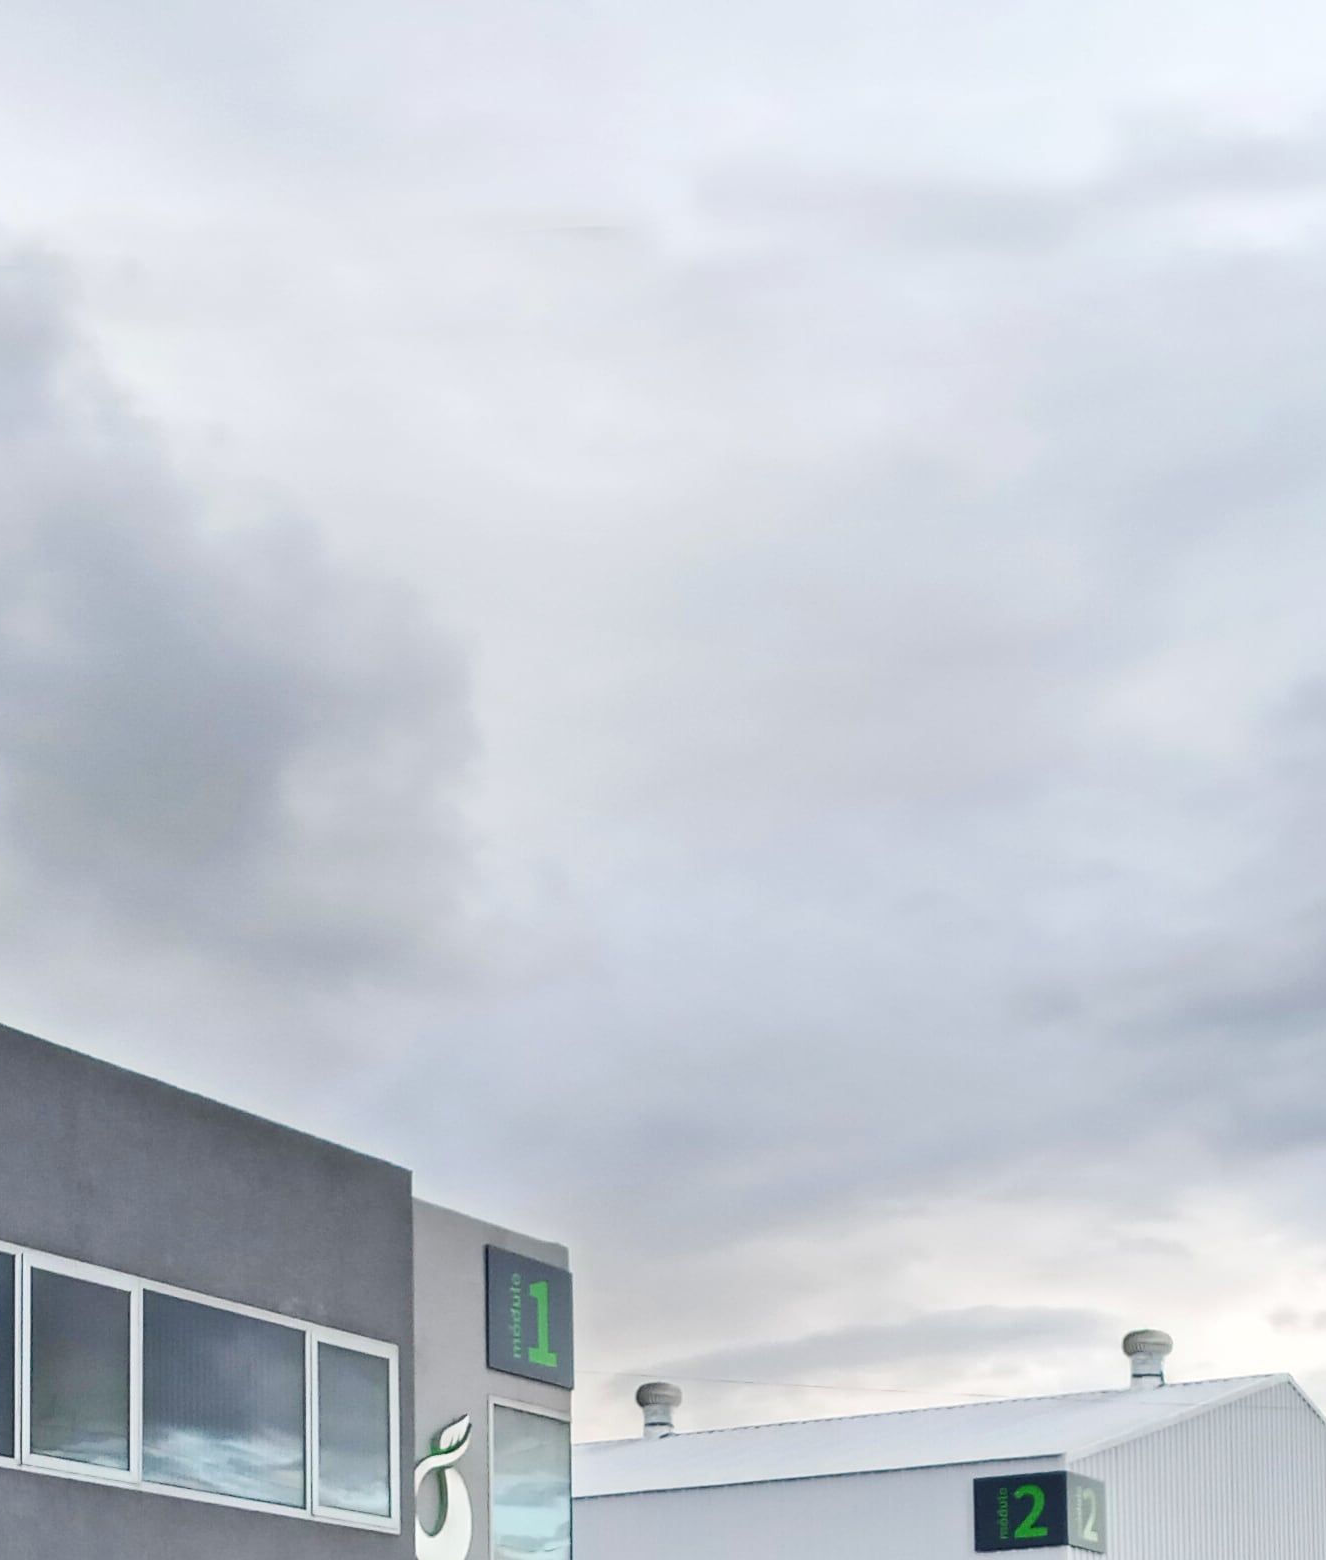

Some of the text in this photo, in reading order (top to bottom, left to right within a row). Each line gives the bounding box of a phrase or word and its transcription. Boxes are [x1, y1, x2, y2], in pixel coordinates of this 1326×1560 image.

[528, 1280, 558, 1368] 1
[1014, 1484, 1048, 1539] 2
[1082, 1487, 1099, 1542] 2
